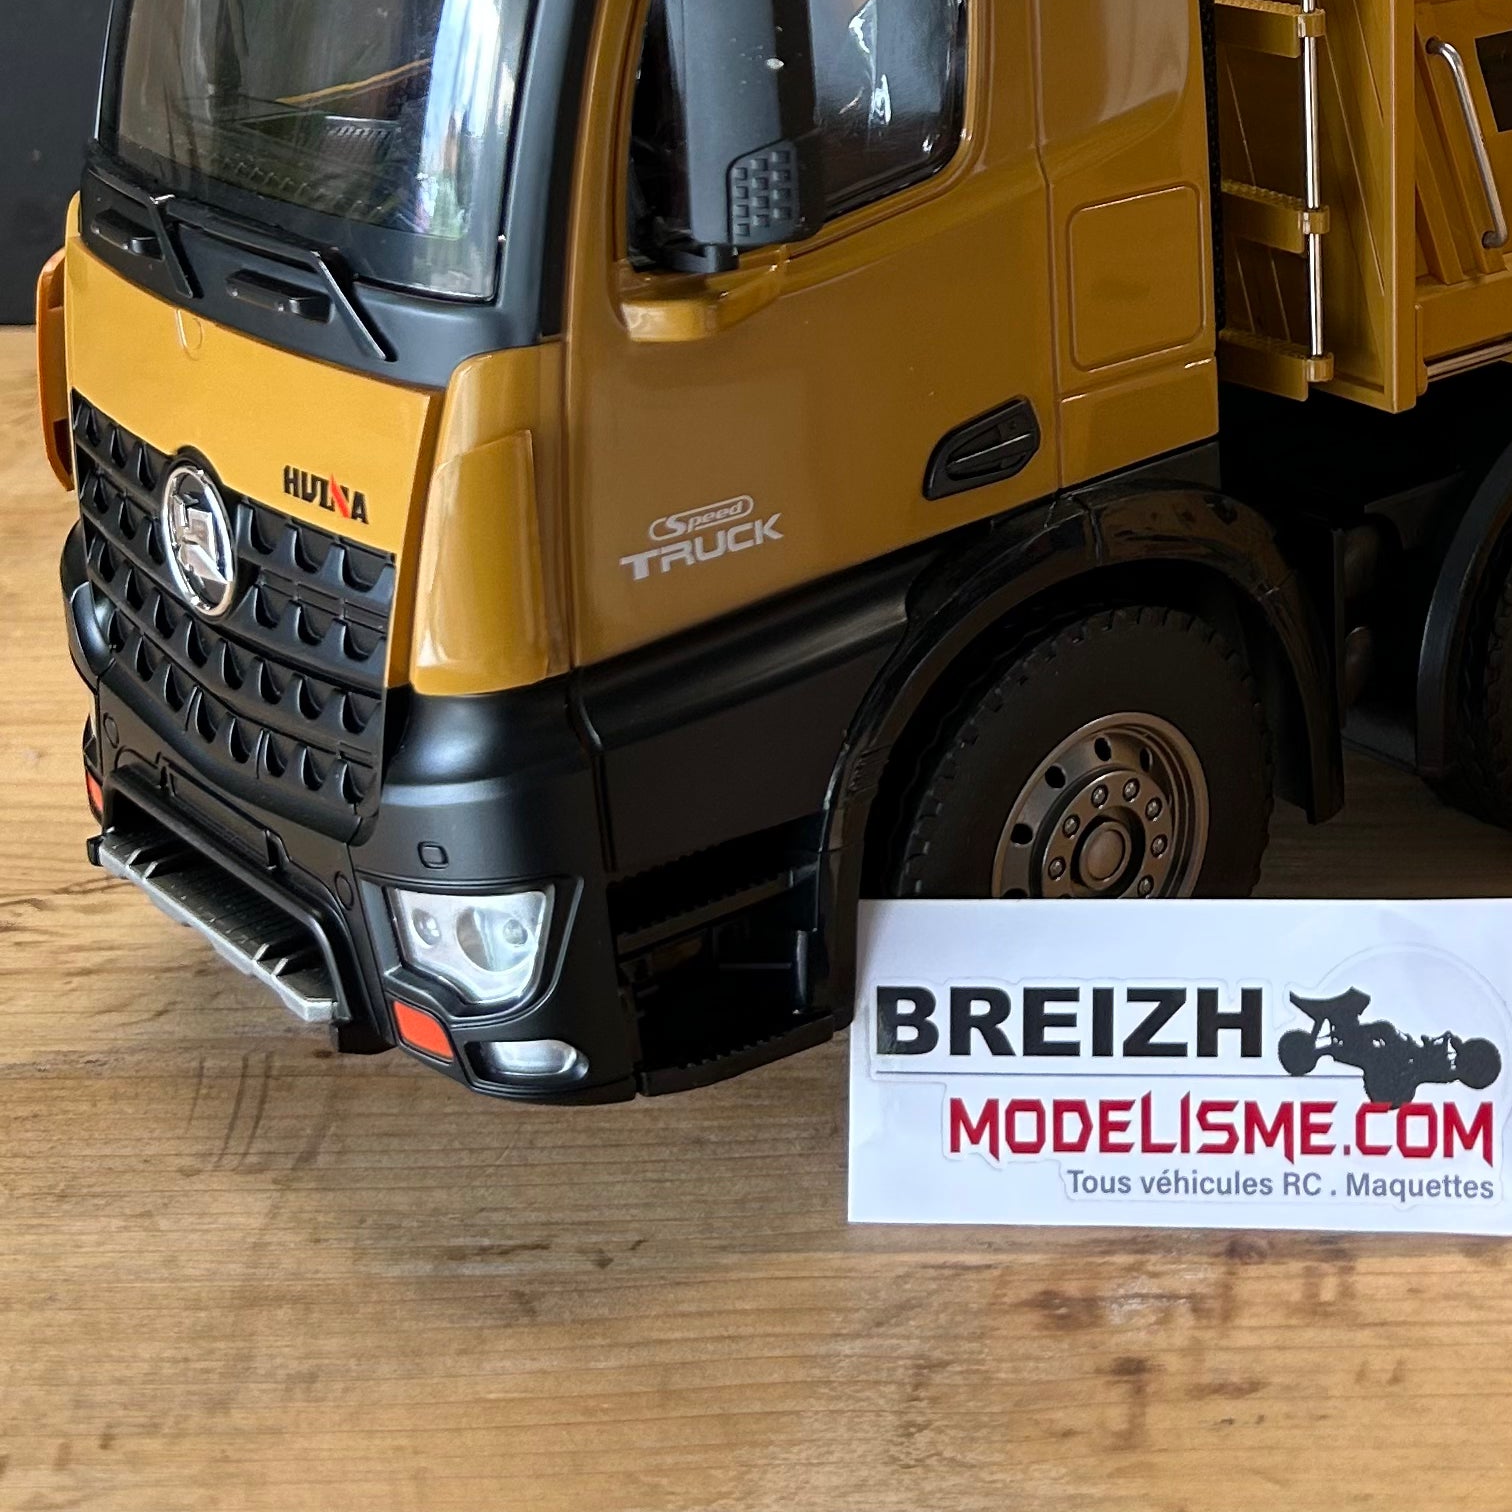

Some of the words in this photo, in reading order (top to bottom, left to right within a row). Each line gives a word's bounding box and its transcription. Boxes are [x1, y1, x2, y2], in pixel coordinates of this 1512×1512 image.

[283, 465, 369, 525] HUINA
[665, 500, 744, 536] Speed
[619, 513, 784, 581] TRUCK
[875, 985, 1263, 1058] BREIZH
[948, 1090, 1494, 1168] MODELISME.COM
[1067, 1168, 1132, 1195] Tous
[1139, 1170, 1274, 1197] véhicules
[1283, 1171, 1321, 1197] RC
[1346, 1171, 1495, 1203] Maquettes
